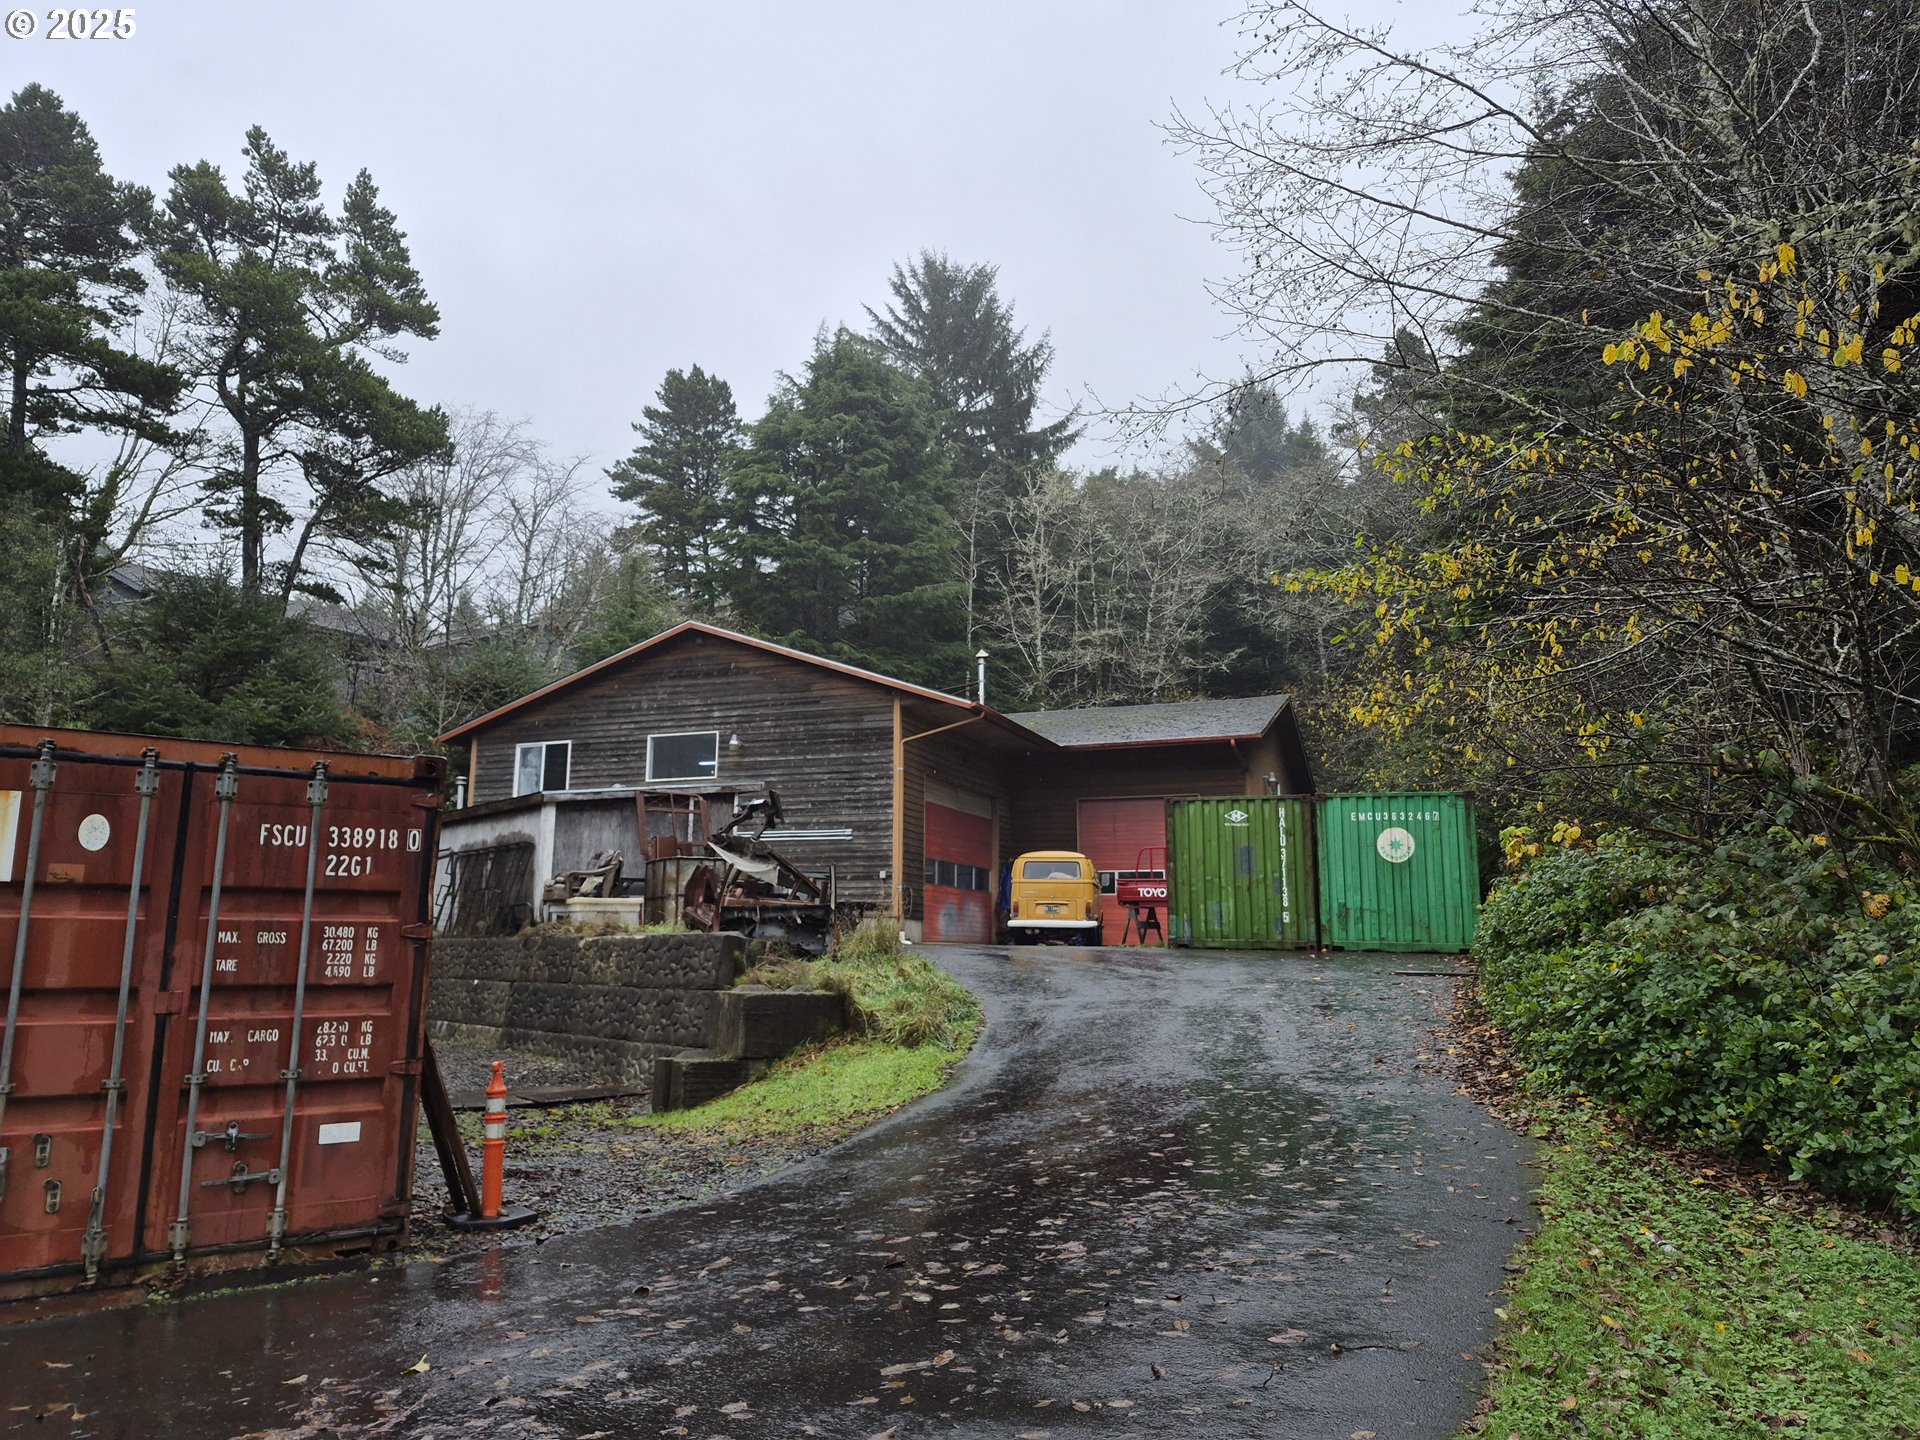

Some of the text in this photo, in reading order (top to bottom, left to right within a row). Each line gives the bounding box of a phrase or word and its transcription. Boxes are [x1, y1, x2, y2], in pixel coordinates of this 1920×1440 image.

[259, 823, 421, 851] FSCU 338918 0
[325, 854, 372, 877] 22G1
[1278, 807, 1286, 847] HALU
[1282, 911, 1290, 923] 5
[1137, 887, 1168, 898] TOYO
[217, 931, 287, 945] MAX. GROSS
[323, 926, 379, 939] 30.480 KG
[321, 939, 378, 951] 67.200 LB
[326, 952, 377, 965] 2.220 KG
[215, 959, 238, 972] TARE
[362, 965, 375, 978] LB
[361, 1020, 373, 1033] KG
[247, 1028, 279, 1043] CARGO
[360, 1033, 372, 1046] LB
[347, 1047, 370, 1060] CU.M.
[206, 1059, 222, 1073] CU.
